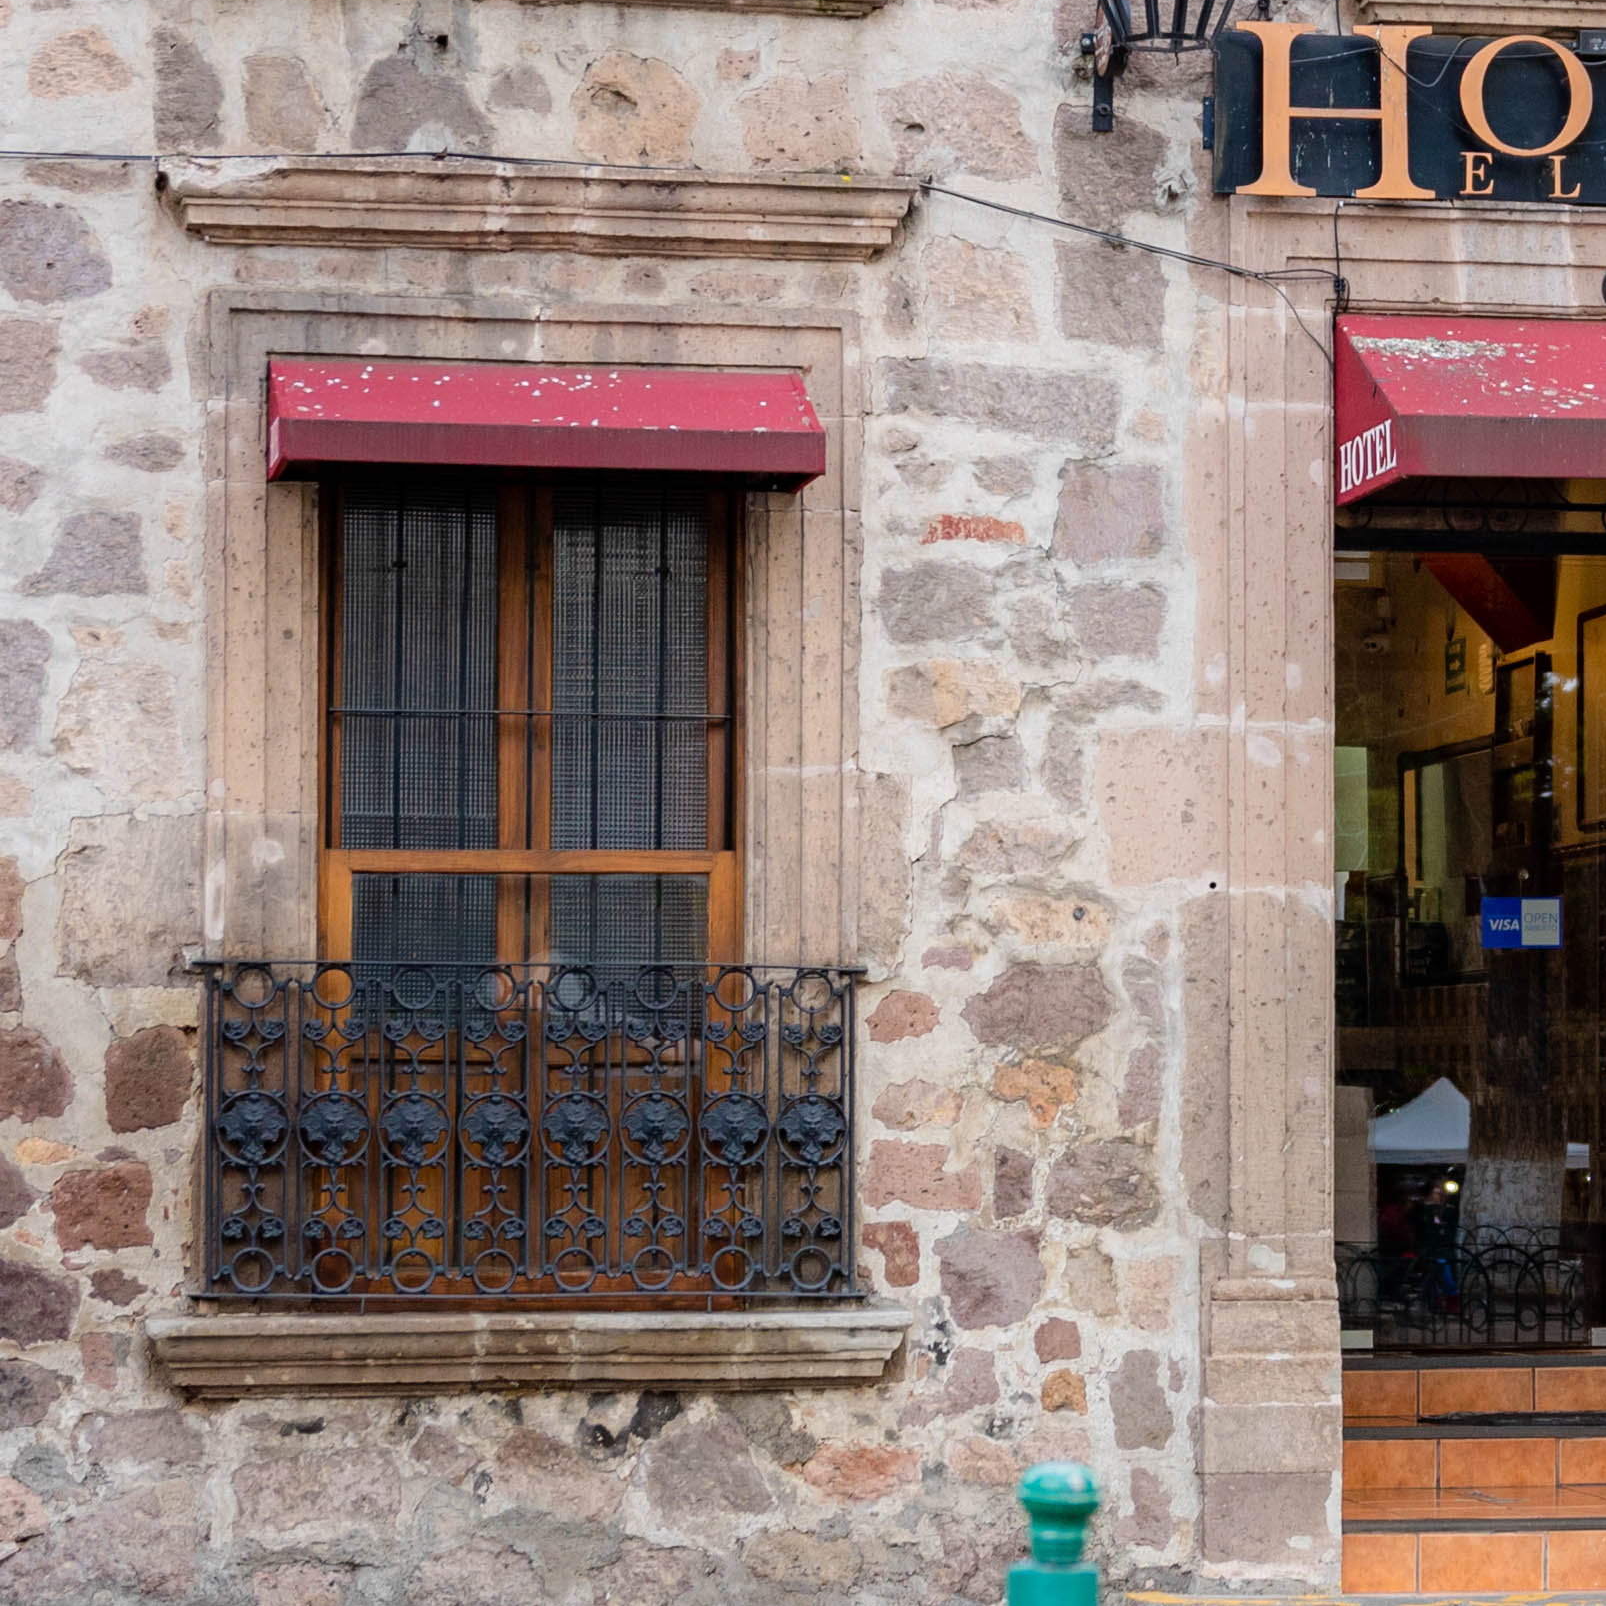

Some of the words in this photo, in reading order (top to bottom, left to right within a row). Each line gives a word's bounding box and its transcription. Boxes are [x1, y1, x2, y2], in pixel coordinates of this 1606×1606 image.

[1459, 151, 1581, 199] EL
[1340, 418, 1397, 494] HOTEL
[1489, 918, 1520, 931] VISA
[1524, 912, 1558, 923] OPEN
